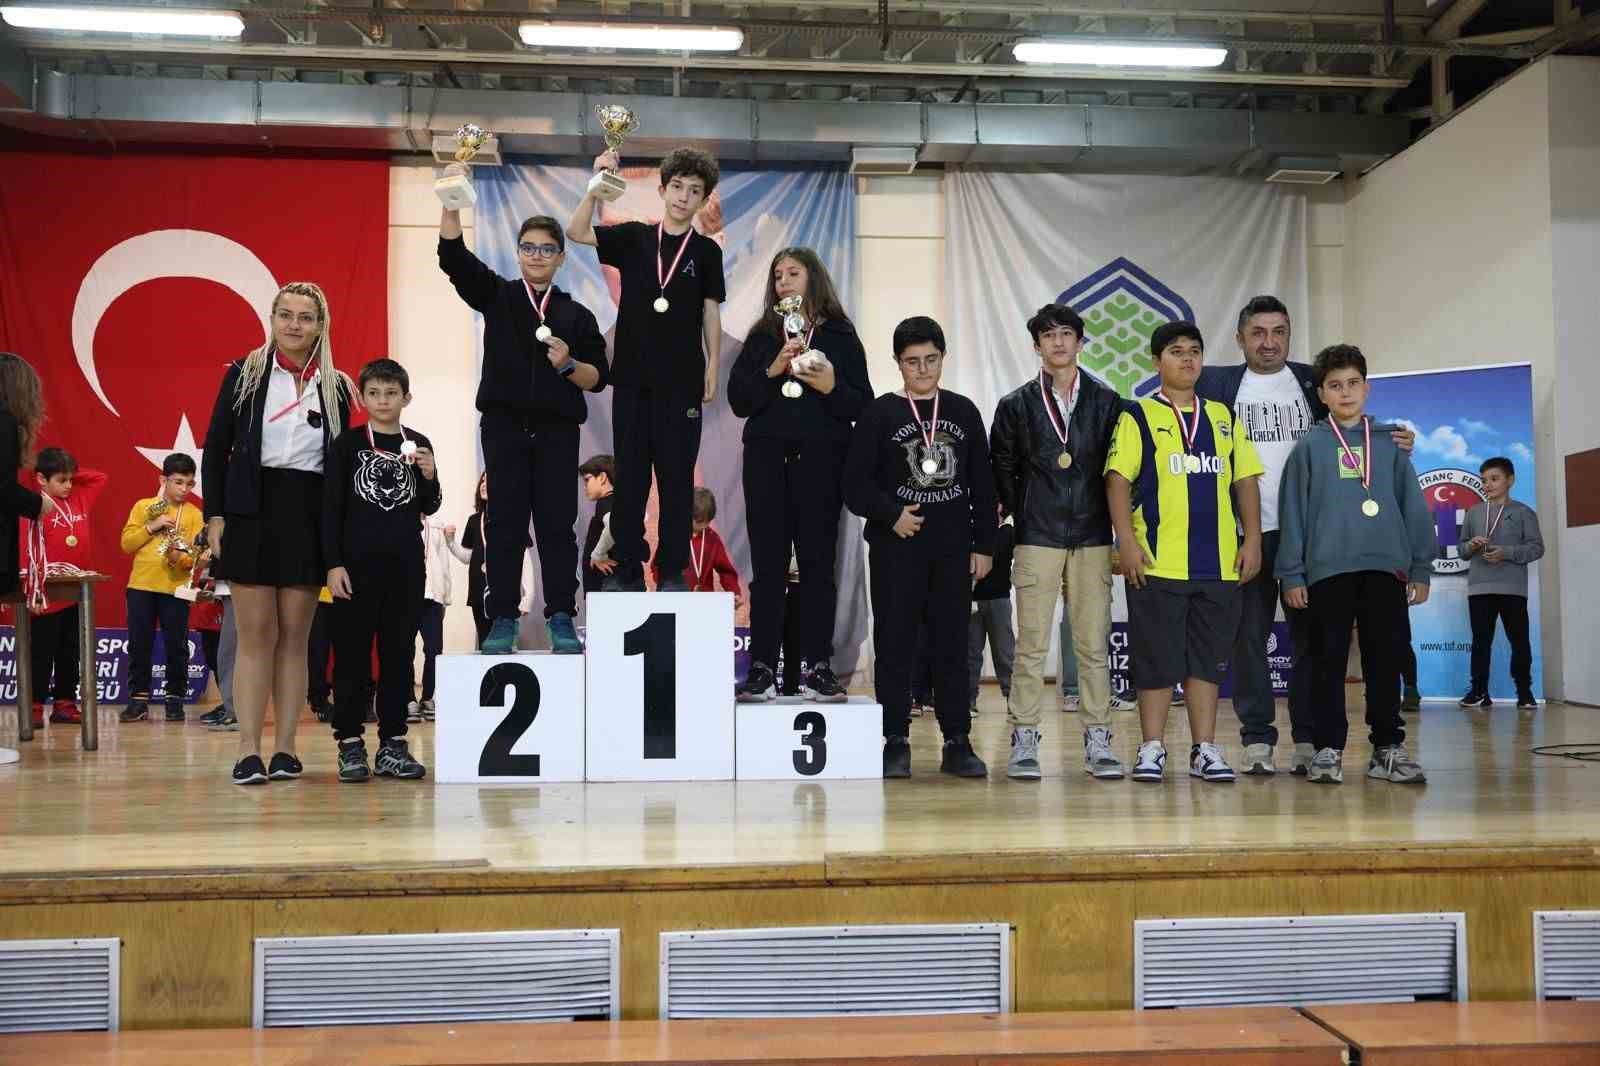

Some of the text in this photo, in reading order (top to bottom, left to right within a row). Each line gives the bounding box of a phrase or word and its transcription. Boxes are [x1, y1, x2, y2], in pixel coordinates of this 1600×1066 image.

[682, 259, 696, 277] A
[1253, 430, 1276, 442] CHECK
[896, 484, 963, 503] ORIGINALS
[623, 612, 676, 760] 1
[478, 661, 541, 777] 2
[792, 710, 827, 776] 3
